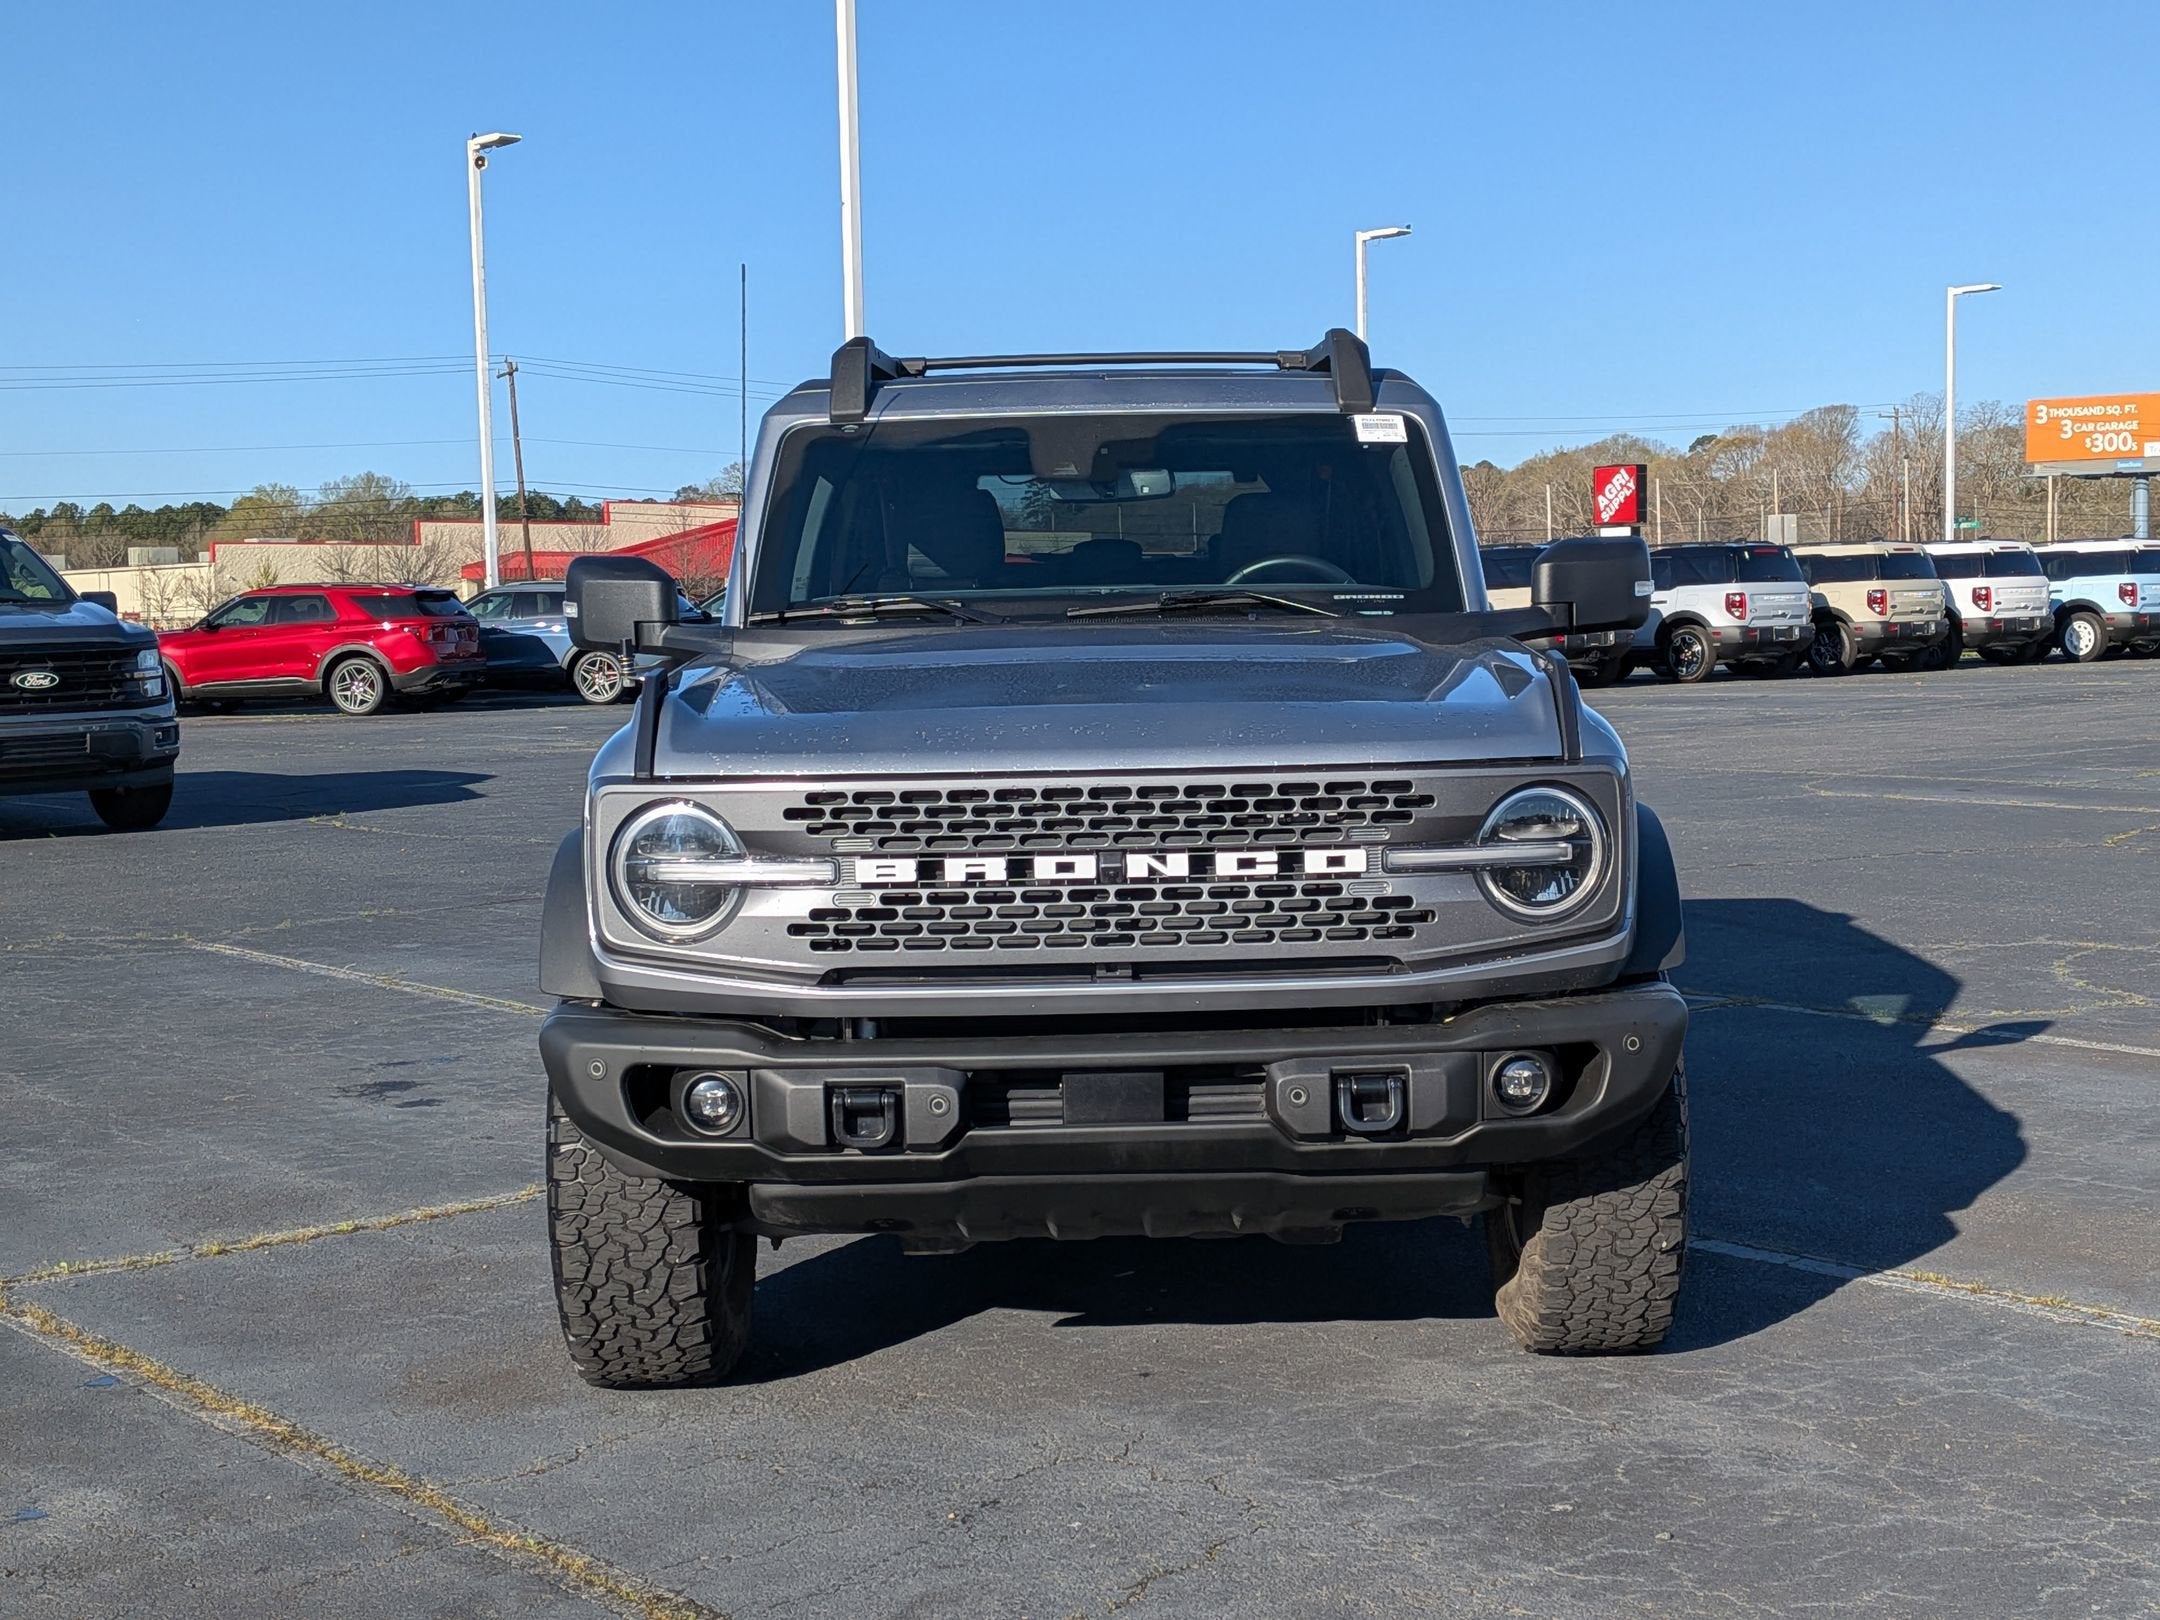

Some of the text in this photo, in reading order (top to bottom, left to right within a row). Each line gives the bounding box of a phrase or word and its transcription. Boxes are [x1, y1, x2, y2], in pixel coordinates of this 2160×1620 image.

[2035, 404, 2138, 424] 3 THOUSAND SQ. FT.
[2060, 419, 2139, 439] 3 CAR GARAGE
[1597, 467, 1630, 511] AGRI
[1601, 476, 1635, 522] SUPPLY
[23, 672, 52, 687] Ford
[855, 849, 1368, 882] BRONCO
